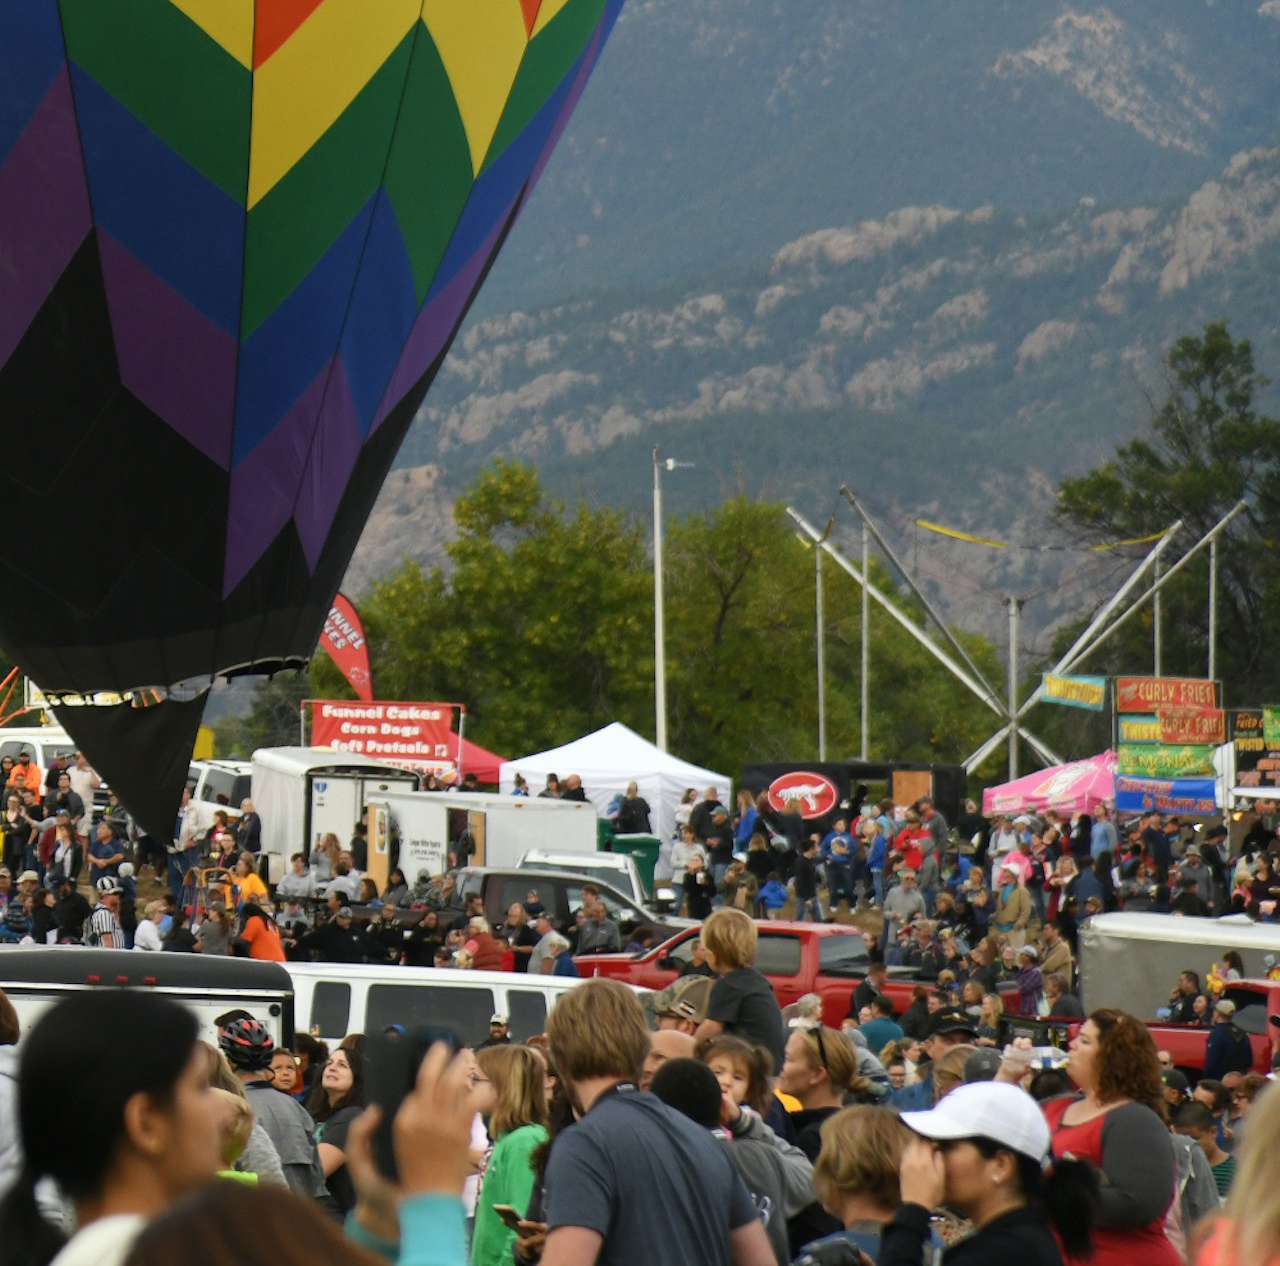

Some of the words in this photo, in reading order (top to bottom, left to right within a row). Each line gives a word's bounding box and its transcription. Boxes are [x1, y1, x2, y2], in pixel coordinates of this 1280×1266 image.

[328, 607, 365, 650] NNEL
[1138, 682, 1175, 702] CURLY
[1179, 683, 1212, 703] FRIES
[321, 704, 383, 719] Funnel
[385, 705, 441, 721] Cakes
[340, 721, 377, 735] Corn
[380, 722, 421, 737] Dogs
[330, 738, 364, 753] Soft
[366, 740, 430, 755] Pretzels
[1155, 794, 1215, 812] WAFFLES
